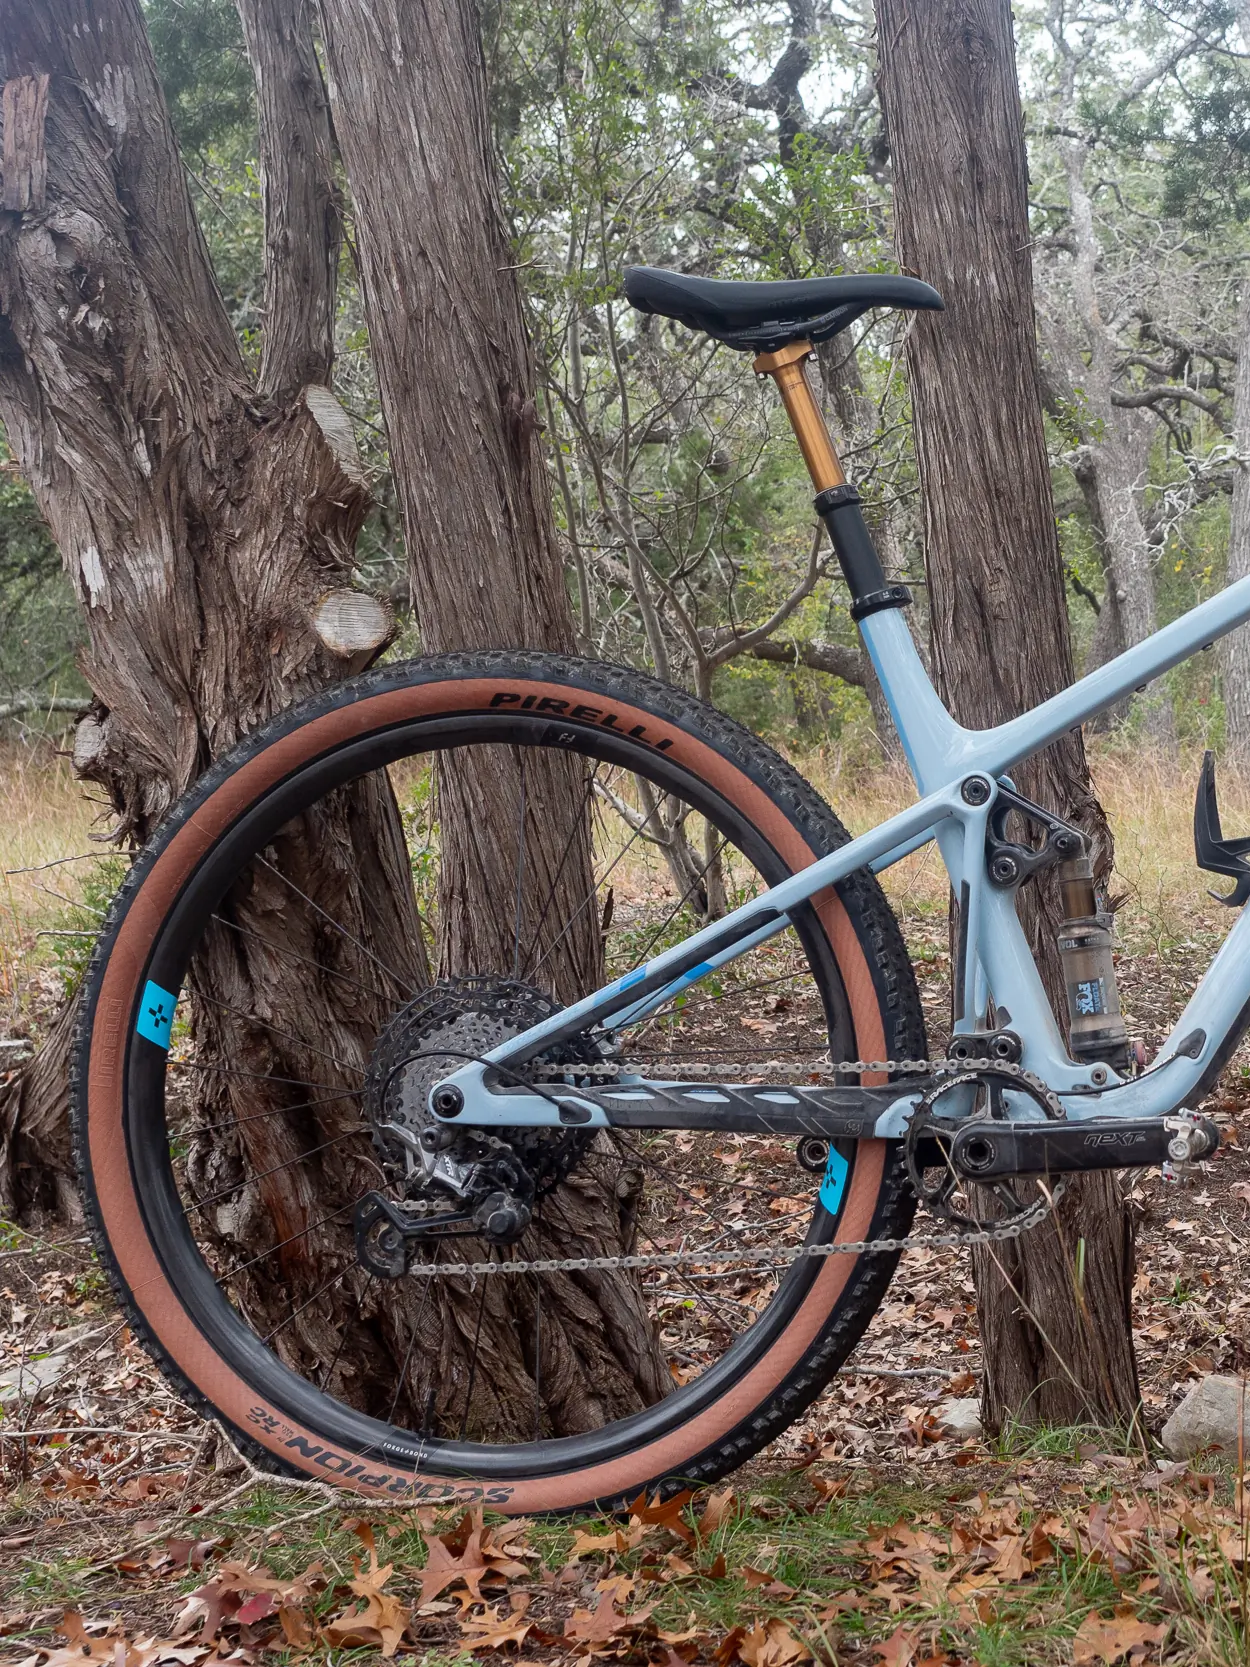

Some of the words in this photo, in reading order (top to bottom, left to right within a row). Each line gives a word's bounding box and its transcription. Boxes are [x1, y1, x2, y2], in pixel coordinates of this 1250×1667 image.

[489, 692, 674, 751] PIRELLI
[1075, 982, 1094, 1015] FOX
[250, 1406, 281, 1428] RC
[283, 1435, 515, 1504] SCORPION
